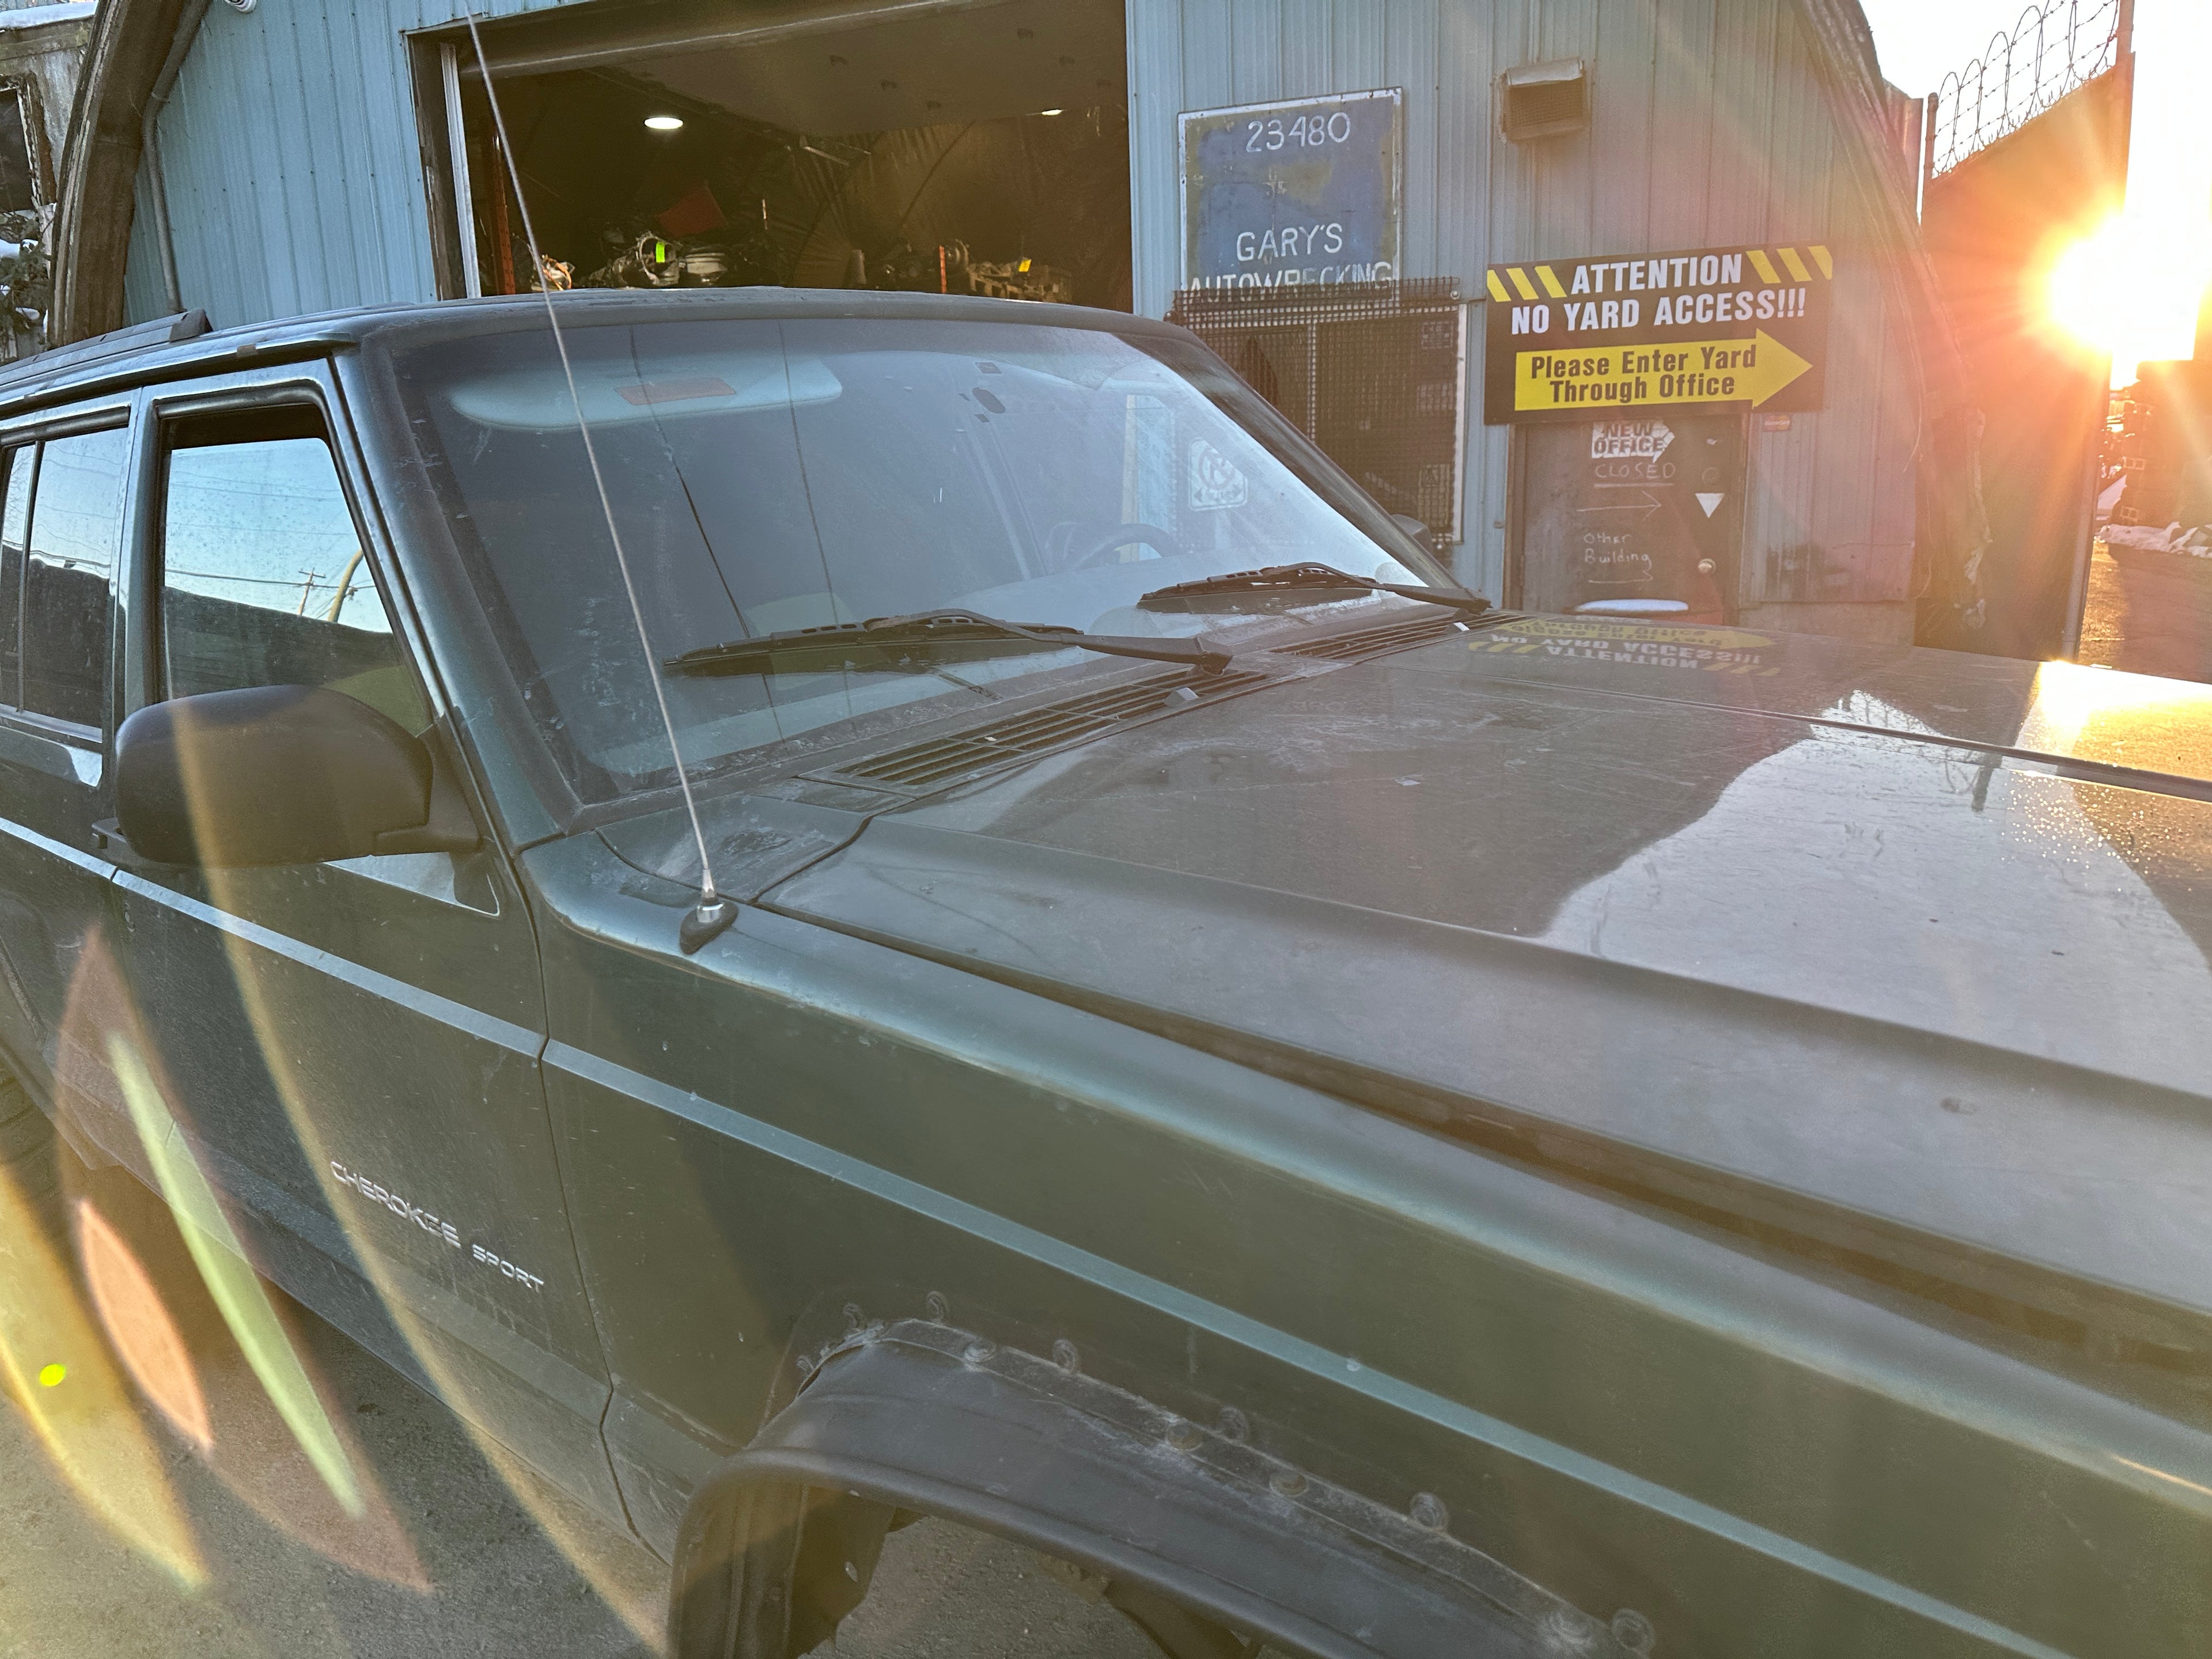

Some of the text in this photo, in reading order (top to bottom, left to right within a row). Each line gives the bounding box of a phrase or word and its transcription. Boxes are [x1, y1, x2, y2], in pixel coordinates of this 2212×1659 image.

[1246, 112, 1351, 153] 23480
[1236, 223, 1343, 262] GARY'S
[1571, 253, 1742, 294] ATTENTION
[1512, 288, 1805, 335] NO YARD ACCESS!!!
[1531, 344, 1756, 379] Please Enter Yard
[1550, 374, 1734, 403] Through Office
[1594, 438, 1665, 454] OFFICE
[1603, 422, 1653, 438] NEW
[1594, 463, 1676, 479] CLOSED
[1585, 548, 1652, 569] Building
[331, 1161, 544, 1293] CHEROKEE SPORT
